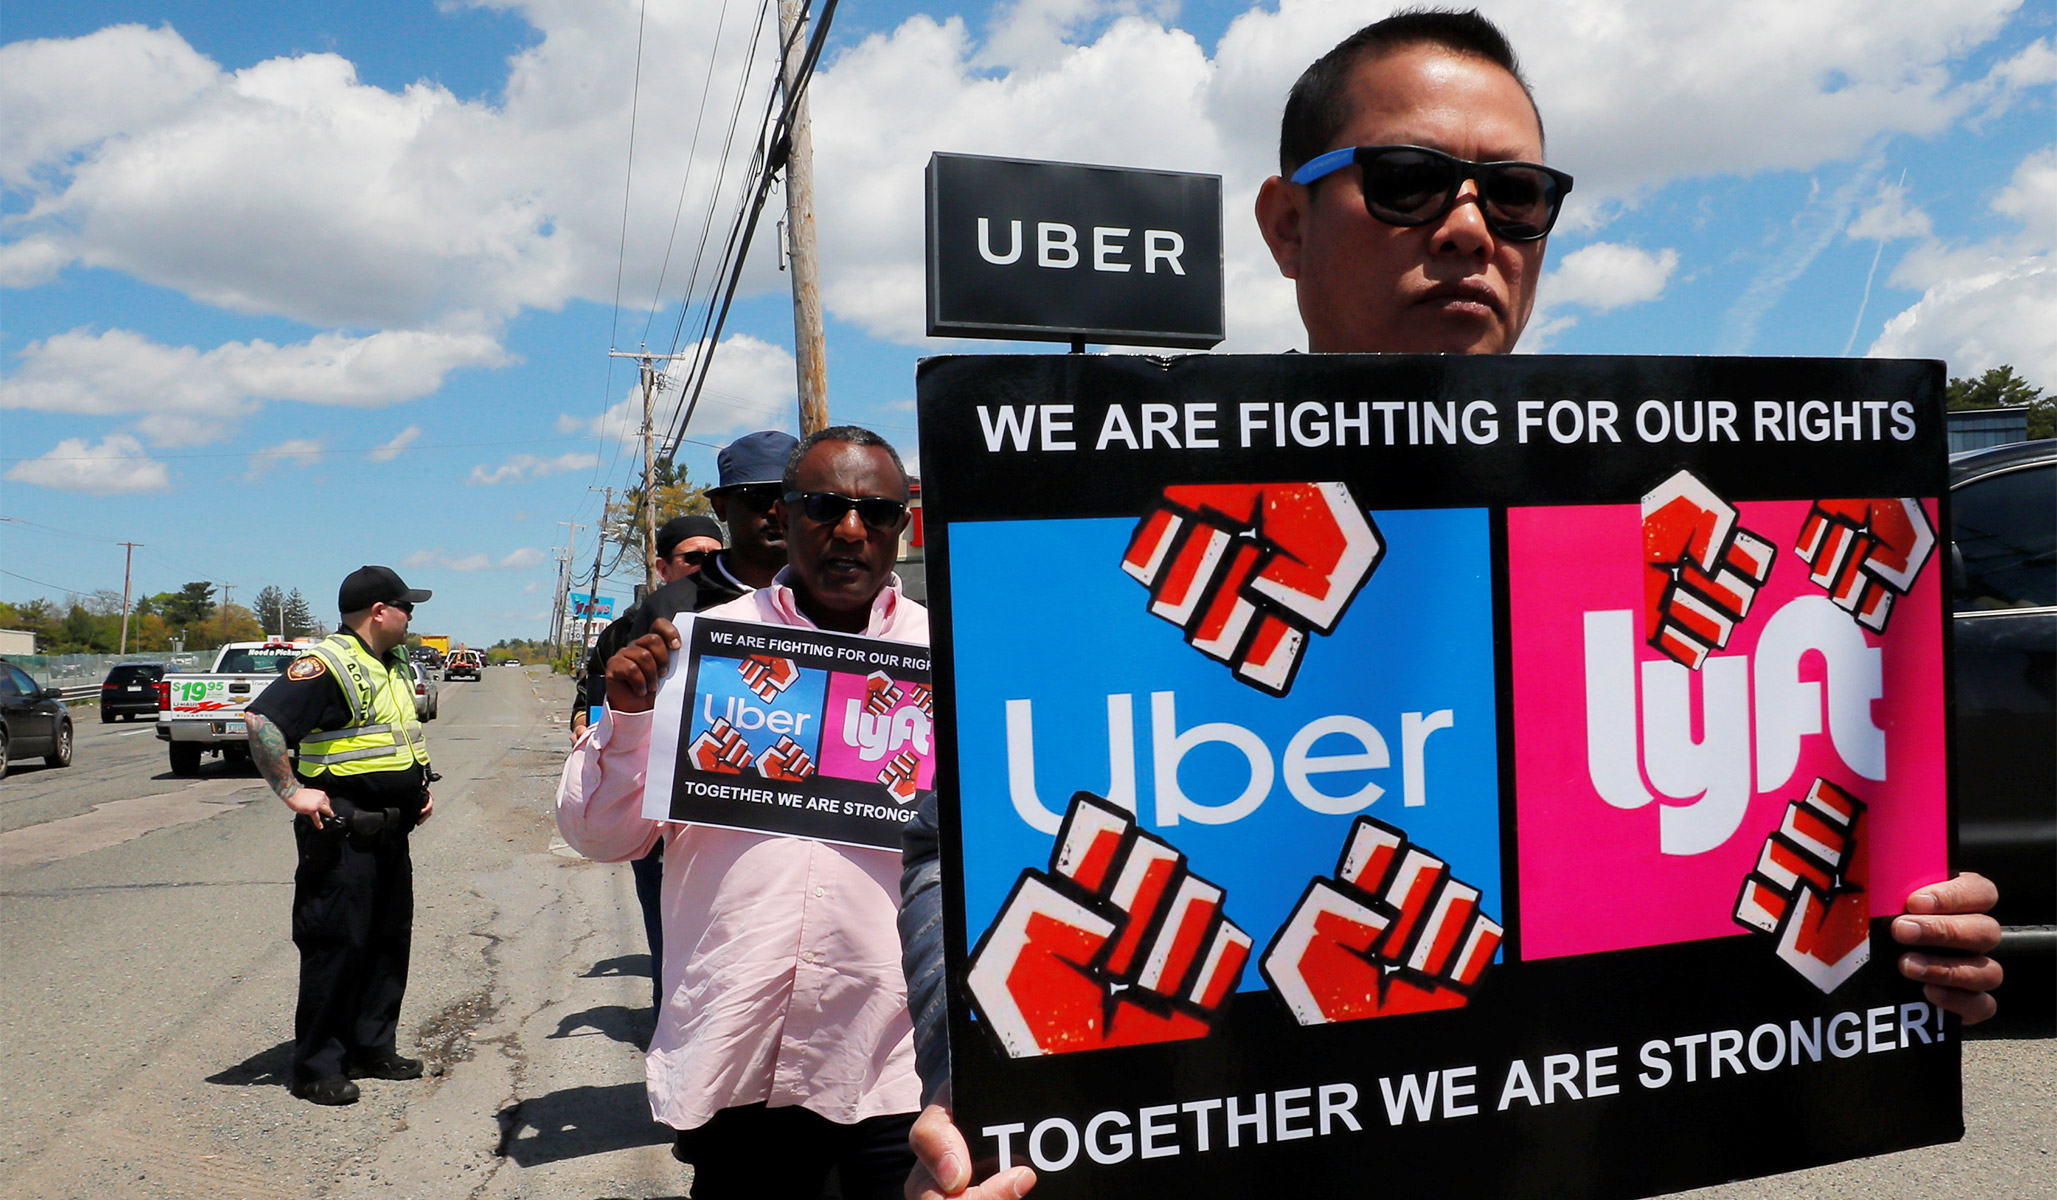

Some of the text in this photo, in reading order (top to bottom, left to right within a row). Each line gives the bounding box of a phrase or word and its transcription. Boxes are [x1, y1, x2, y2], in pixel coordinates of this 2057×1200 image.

[977, 217, 1186, 276] UBER
[976, 399, 1916, 453] WE ARE FIGHTING FOR OUR RIGHTS
[709, 631, 732, 645] WE
[735, 635, 766, 649] ARE
[768, 638, 834, 658] FIGHTING
[836, 647, 866, 662] FOR
[868, 652, 899, 667] OUR
[346, 663, 369, 721] POLICE
[703, 693, 812, 736] Uber
[842, 698, 932, 762] lyft
[1583, 594, 1887, 857] lyft
[1005, 690, 1455, 836] Uber
[684, 781, 774, 805] TOGETHER
[777, 793, 804, 809] WE
[805, 796, 841, 814] ARE
[982, 1001, 1946, 1172] TOGETHER WE ARE STRONGER!
